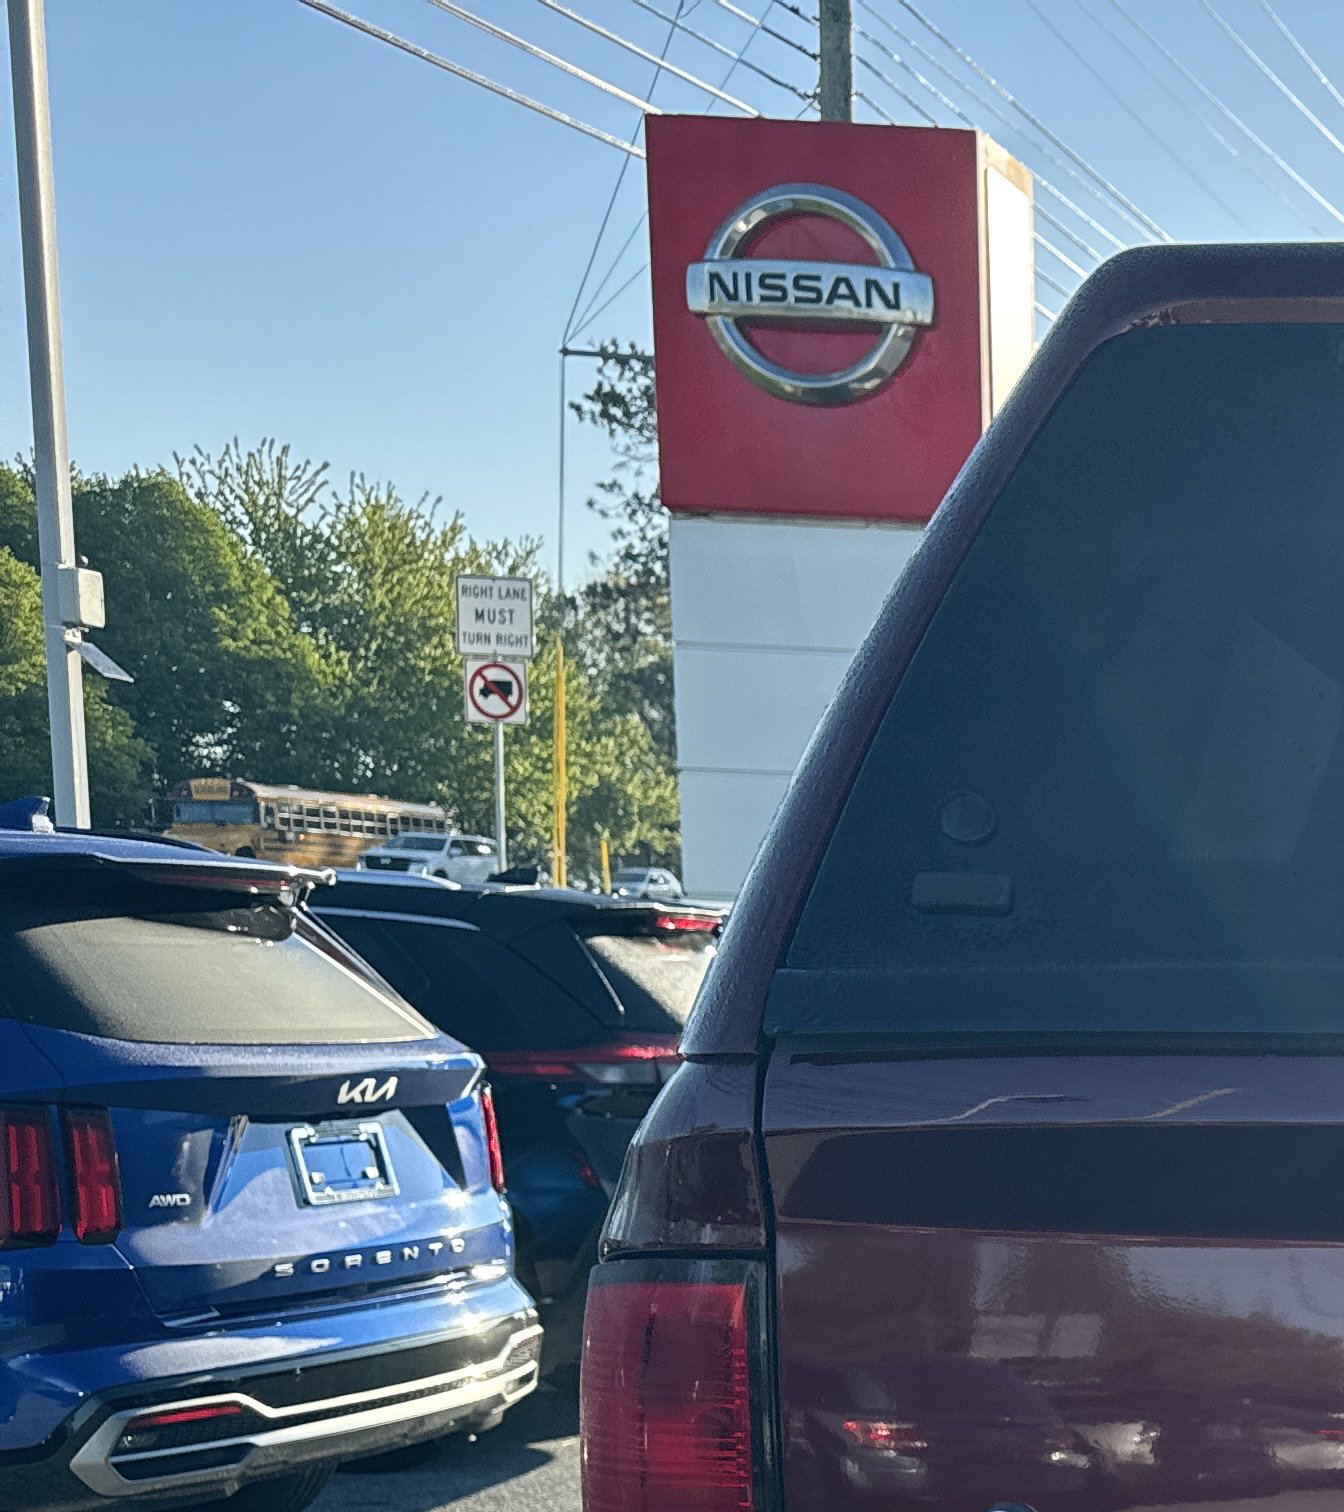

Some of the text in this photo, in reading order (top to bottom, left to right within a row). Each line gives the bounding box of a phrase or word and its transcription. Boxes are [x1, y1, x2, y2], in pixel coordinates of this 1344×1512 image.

[707, 271, 901, 310] NISSAN
[461, 584, 527, 602] RIGHT LANE
[474, 607, 515, 625] MUST
[462, 631, 528, 648] TURN RIGHT
[337, 1076, 399, 1104] KIA
[149, 1193, 191, 1208] AWD
[274, 1238, 466, 1278] SORENTO
